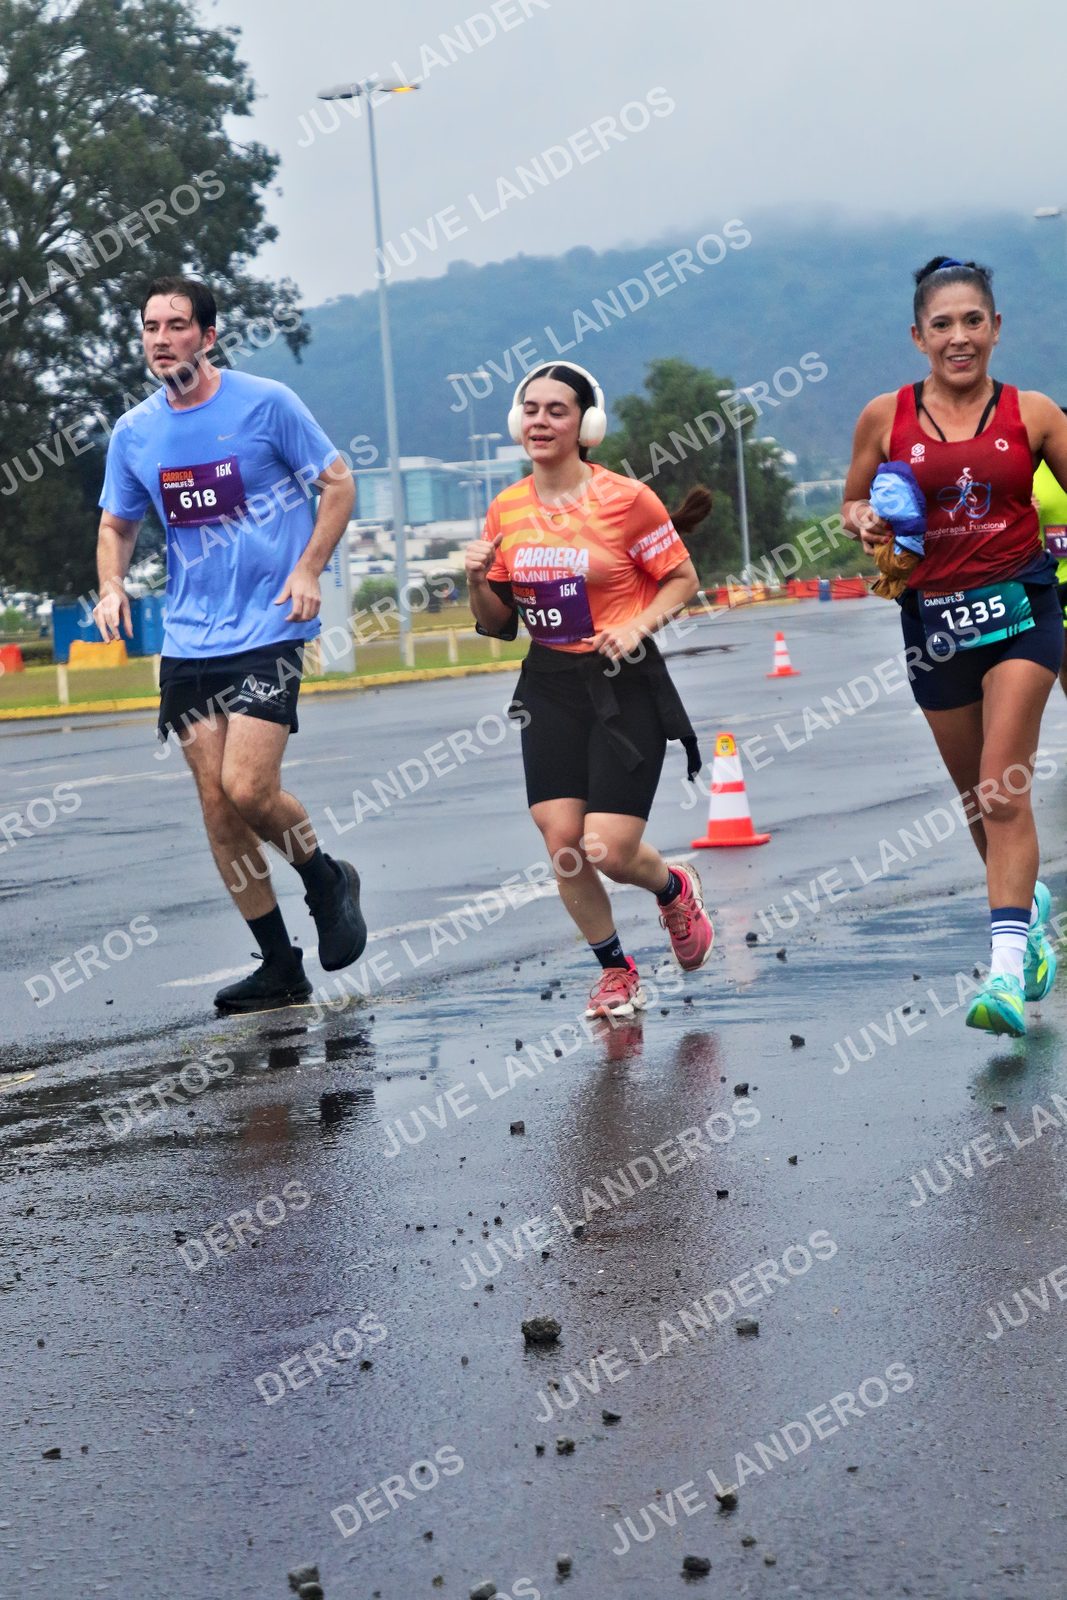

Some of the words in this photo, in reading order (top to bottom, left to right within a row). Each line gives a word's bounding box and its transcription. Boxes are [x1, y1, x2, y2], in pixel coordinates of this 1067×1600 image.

[163, 470, 193, 482] CARRERA
[215, 463, 232, 477] 15K
[180, 489, 217, 509] 618
[969, 520, 1006, 531] Funcional
[514, 547, 589, 568] CARRERA
[560, 583, 577, 597] 15K
[924, 596, 955, 606] OMNILIFE
[526, 608, 562, 627] 619
[941, 595, 1006, 630] 1235
